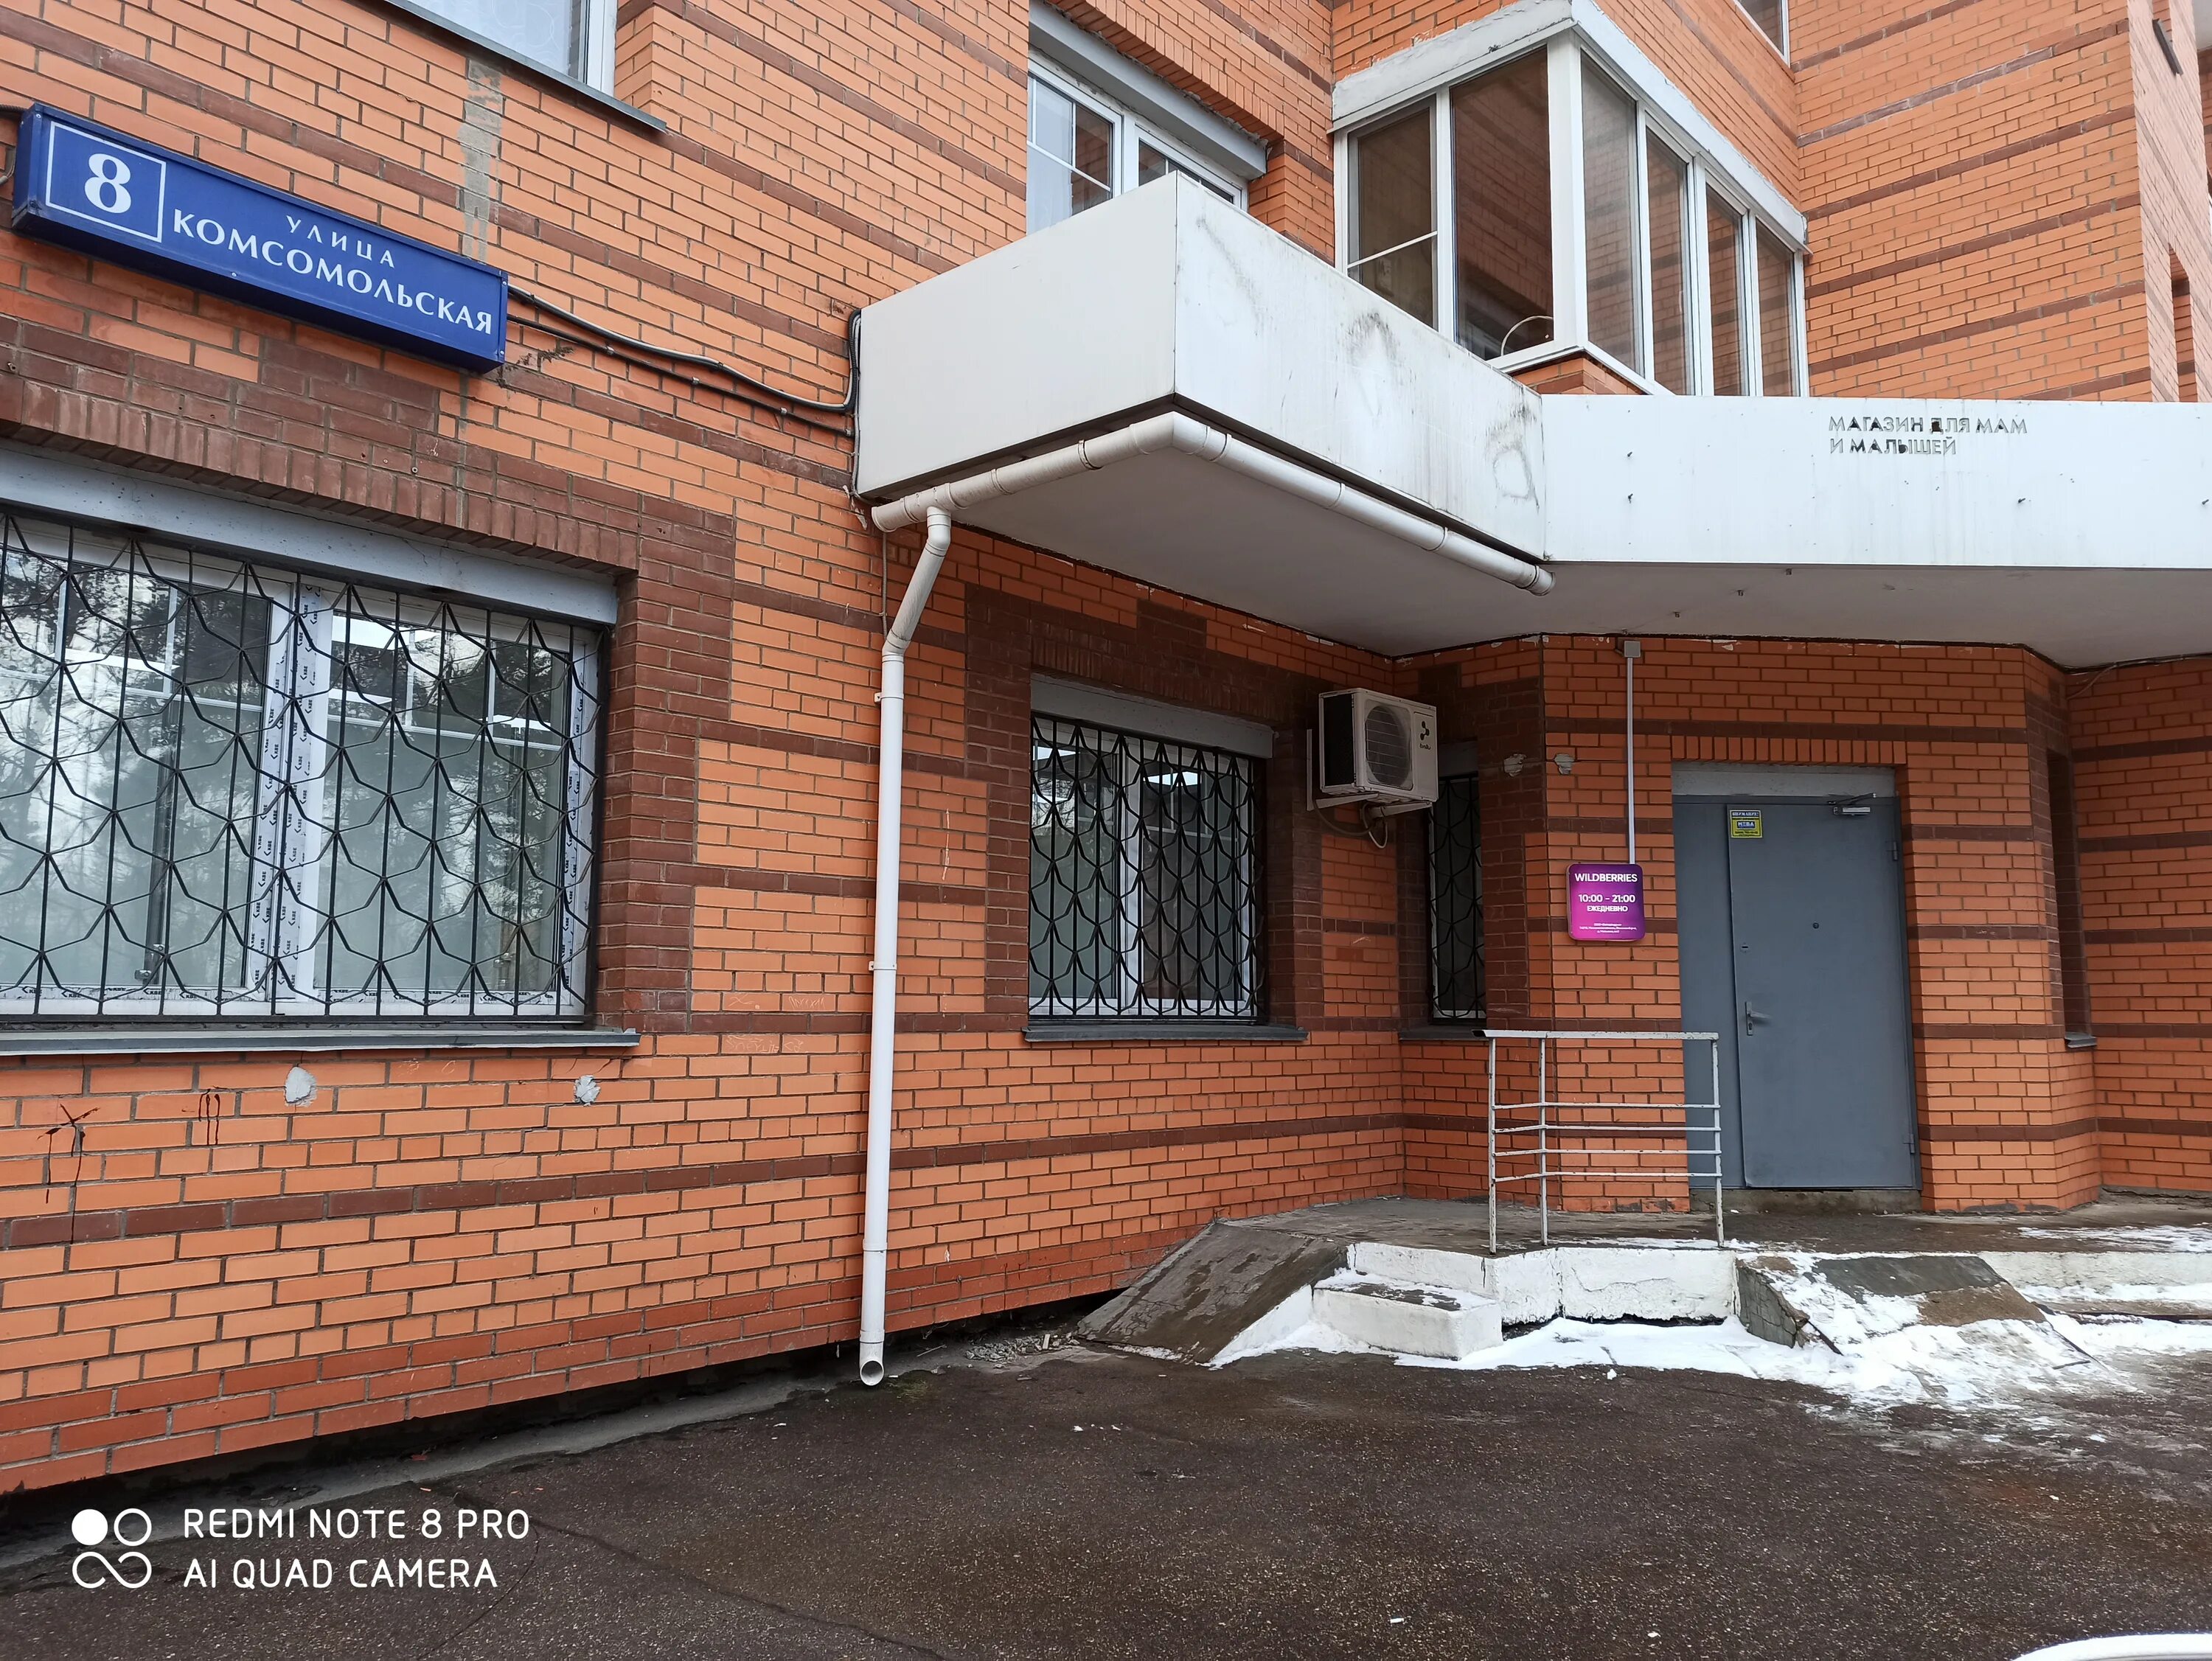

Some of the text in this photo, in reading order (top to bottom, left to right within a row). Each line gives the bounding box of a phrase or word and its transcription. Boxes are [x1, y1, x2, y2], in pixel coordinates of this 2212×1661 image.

[84, 153, 131, 213] 8
[287, 215, 395, 268] УЛИЦА
[173, 209, 492, 335] КОМСОМОЛЬСКАЯ
[1829, 416, 2027, 434] МАГАЗИН ДЛЯ МАМ
[1830, 436, 1956, 455] И МАЛЫШЕЙ
[1574, 873, 1638, 882] WILDBERRIES
[1579, 894, 1603, 902] 10:00
[1611, 894, 1636, 903] 21:00
